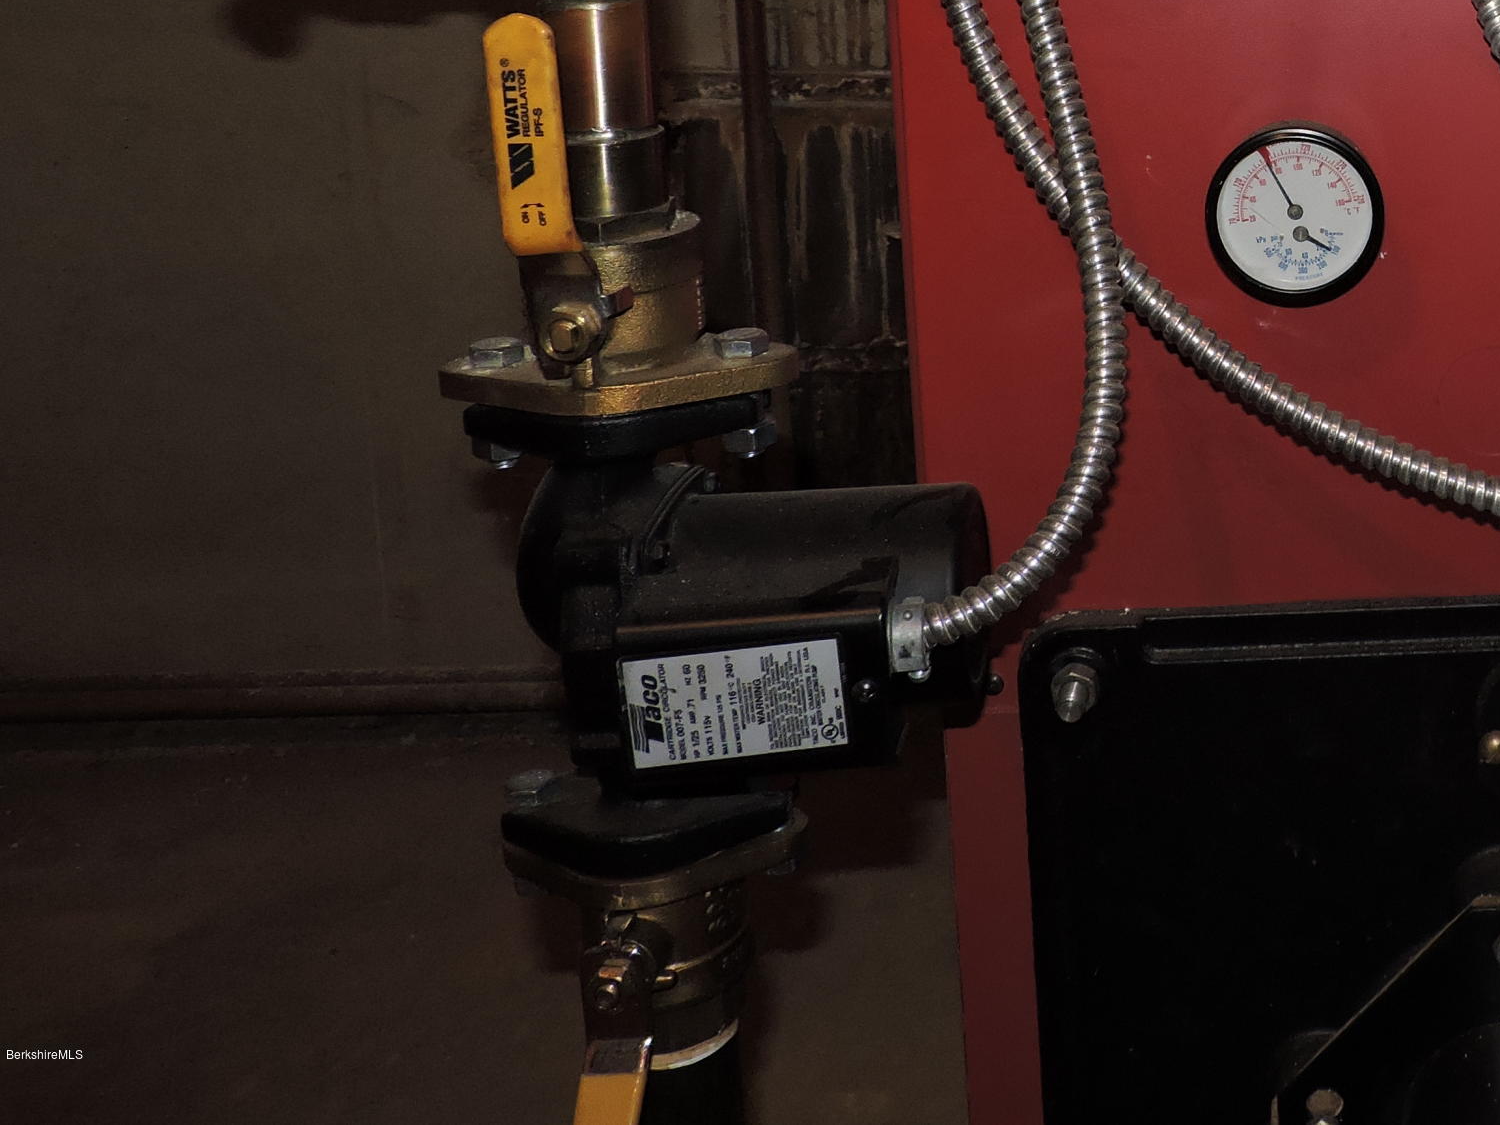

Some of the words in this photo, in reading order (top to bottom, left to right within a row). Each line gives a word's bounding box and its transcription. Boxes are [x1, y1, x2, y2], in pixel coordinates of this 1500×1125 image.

[501, 69, 521, 140] WATTS
[516, 68, 532, 138] REGULATOR
[538, 210, 548, 226] OFF
[724, 662, 735, 679] 240
[629, 674, 665, 754] Taco
[751, 678, 767, 725] WARNING
[664, 716, 677, 761] CARTRIDGE
[677, 738, 688, 760] MODEL
[690, 730, 701, 747] 1/25
[706, 736, 715, 756] VOLTS
